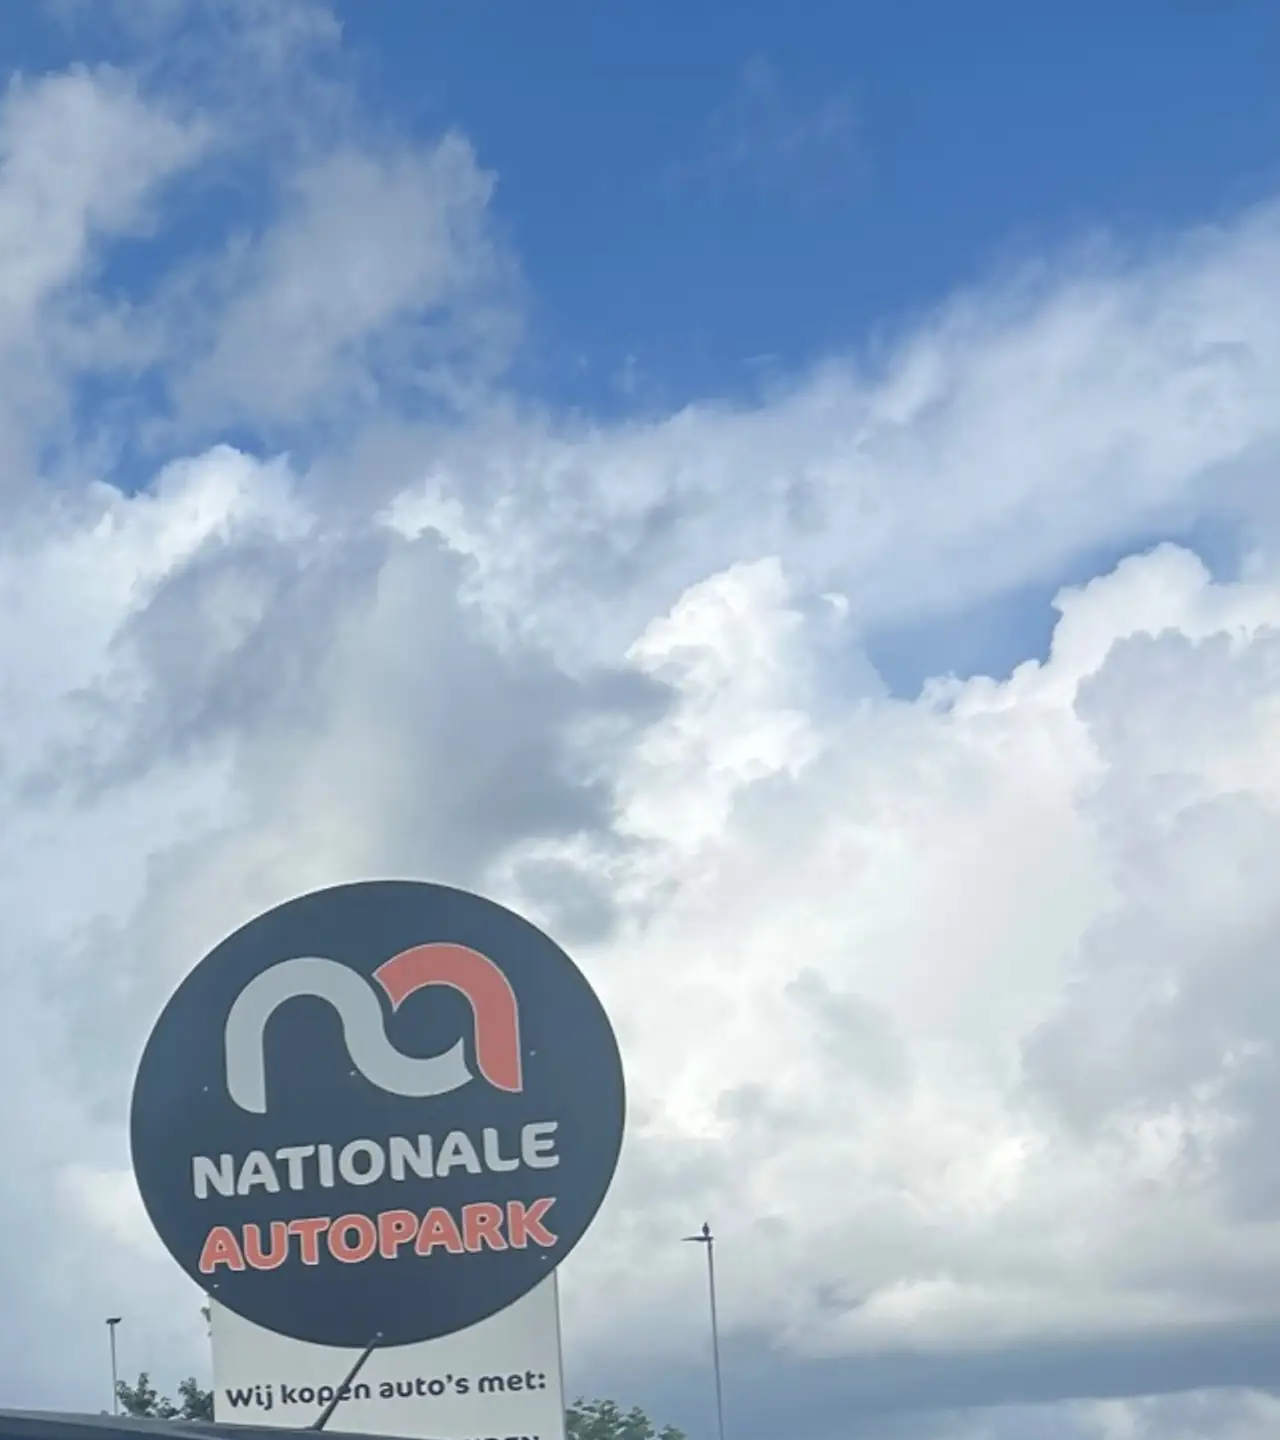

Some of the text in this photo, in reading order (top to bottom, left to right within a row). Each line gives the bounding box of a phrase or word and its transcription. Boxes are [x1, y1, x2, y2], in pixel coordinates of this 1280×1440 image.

[192, 1121, 560, 1200] NATIONALE
[199, 1197, 559, 1274] AUTOPARK
[225, 1370, 547, 1411] Wij kopen auto's met:
